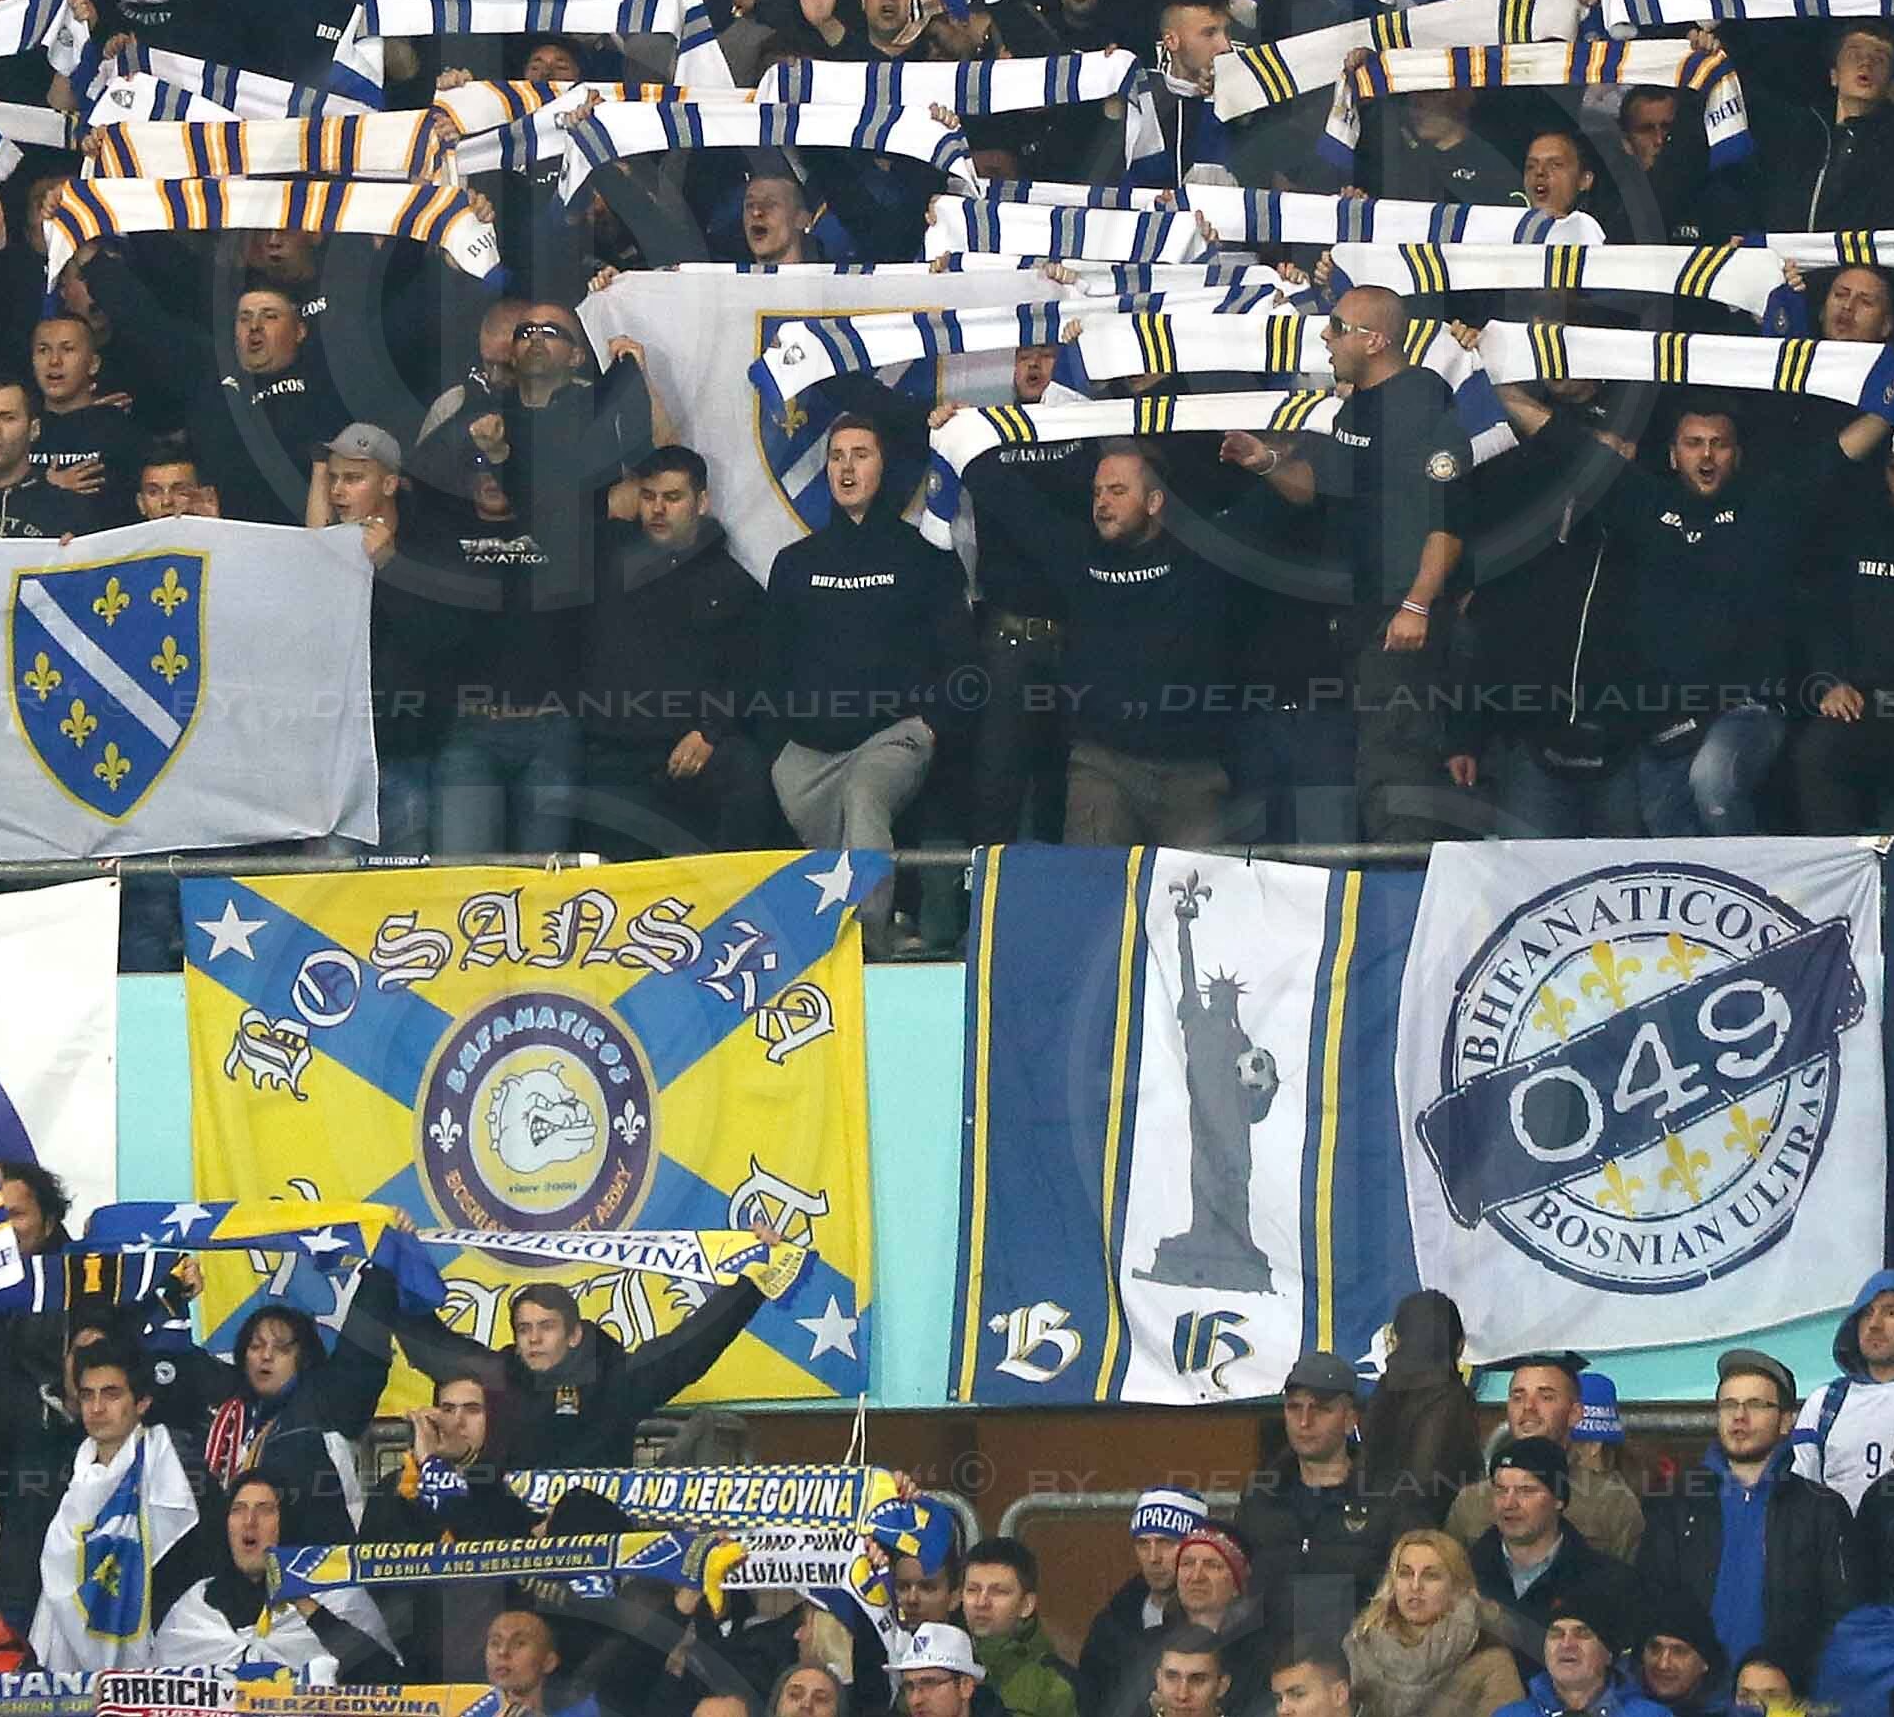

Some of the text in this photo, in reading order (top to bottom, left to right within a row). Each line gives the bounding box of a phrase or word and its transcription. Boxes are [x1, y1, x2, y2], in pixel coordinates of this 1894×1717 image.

[811, 573, 895, 590] BHFANATICOS
[1462, 885, 1784, 1067] BHFANATICOS
[445, 1004, 632, 1094] BHFANATICOS
[1508, 977, 1793, 1163] 049
[1524, 1063, 1829, 1266] BOSNIAN ULTRAS
[1866, 1442, 1883, 1479] 9
[625, 1473, 680, 1508] AND
[682, 1473, 854, 1519] HERZEGOVINA
[98, 1677, 218, 1709] ERREICH
